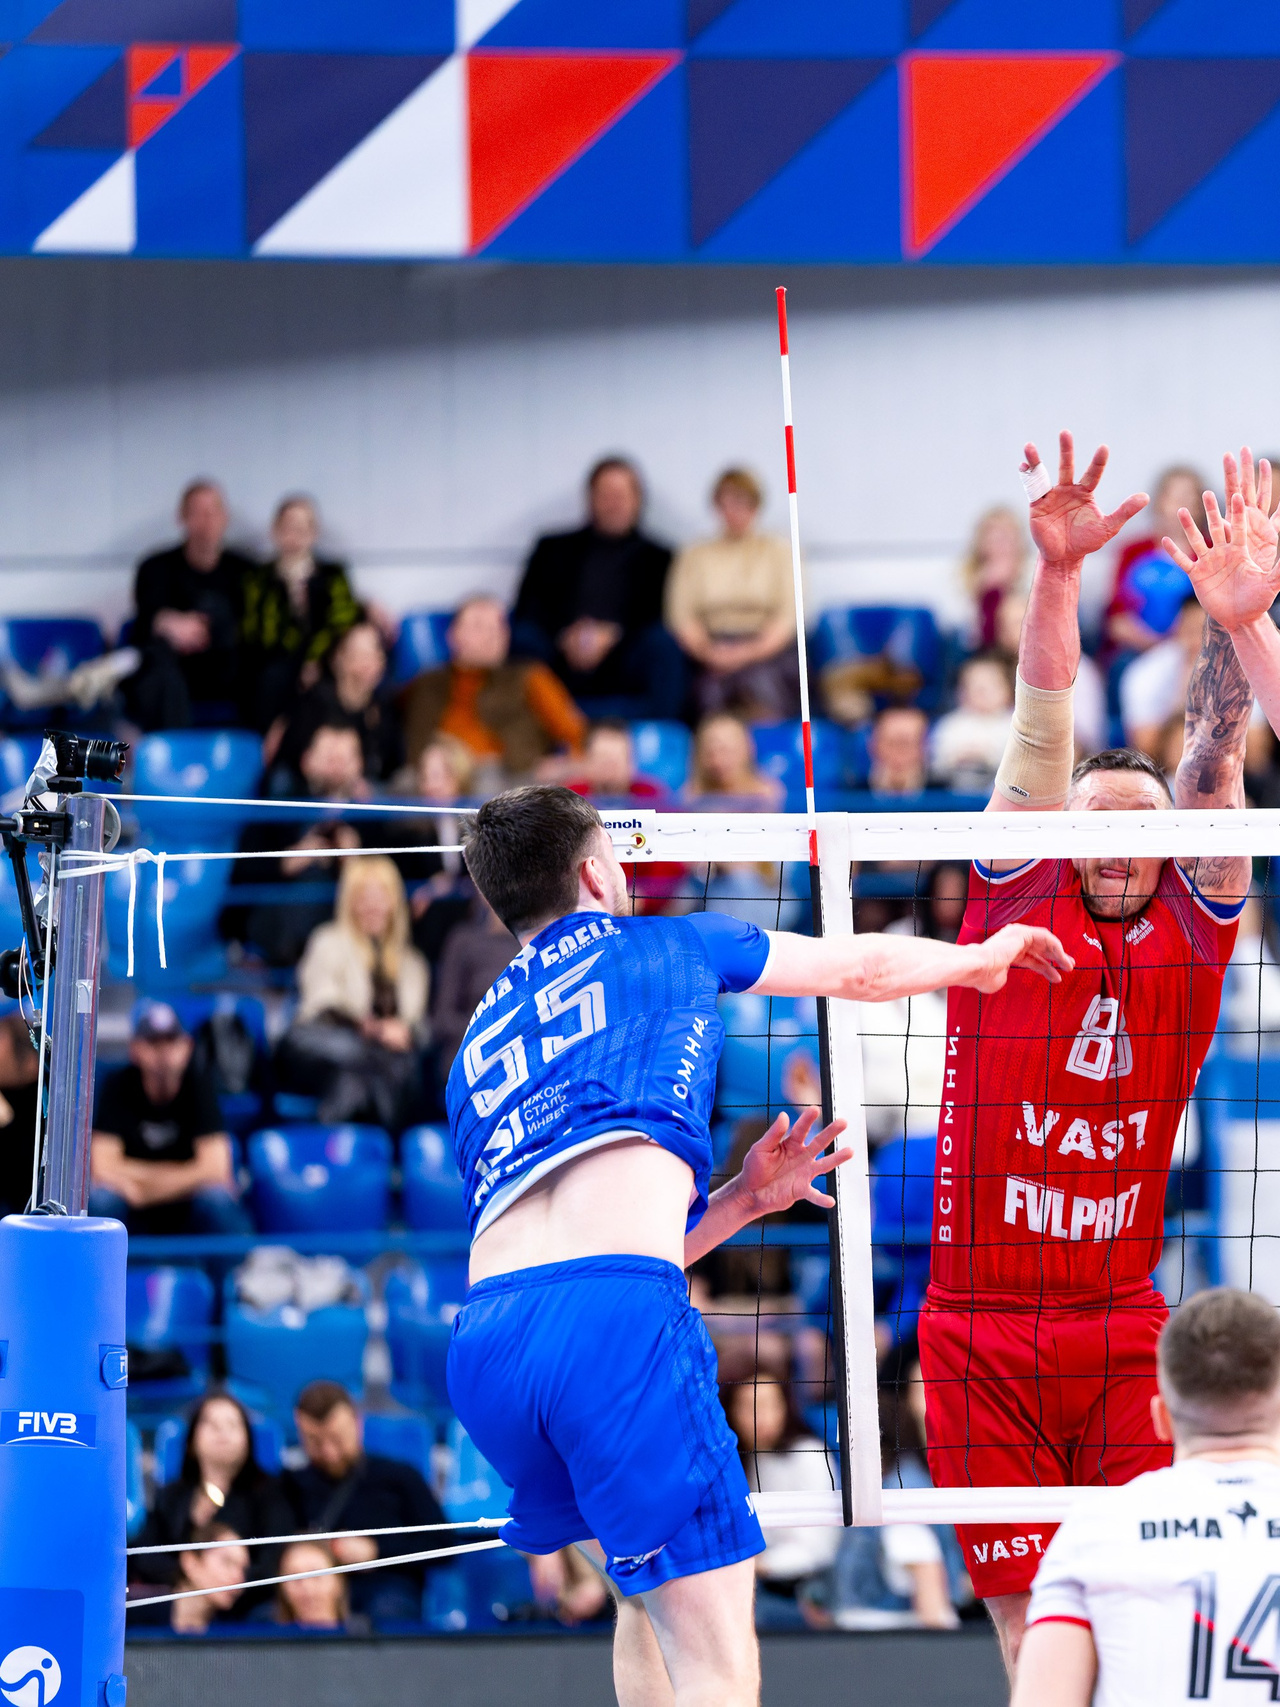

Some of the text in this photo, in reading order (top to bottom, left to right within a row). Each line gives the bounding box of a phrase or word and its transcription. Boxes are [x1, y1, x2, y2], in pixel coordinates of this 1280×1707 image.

[604, 819, 642, 829] enoh
[558, 927, 622, 964] company
[462, 976, 514, 1041] IMA
[463, 950, 607, 1118] 55
[1065, 993, 1133, 1081] 8
[522, 1080, 570, 1110] ИЖОРА
[524, 1093, 567, 1122] СТАЛЬ
[527, 1101, 574, 1135] ИНВЕС
[939, 1026, 961, 1242] ВСПОМНИ.
[1015, 1100, 1149, 1160] VAST
[18, 1411, 77, 1434] FIVB
[1140, 1517, 1223, 1540] DIMA
[971, 1533, 1046, 1565] VAST
